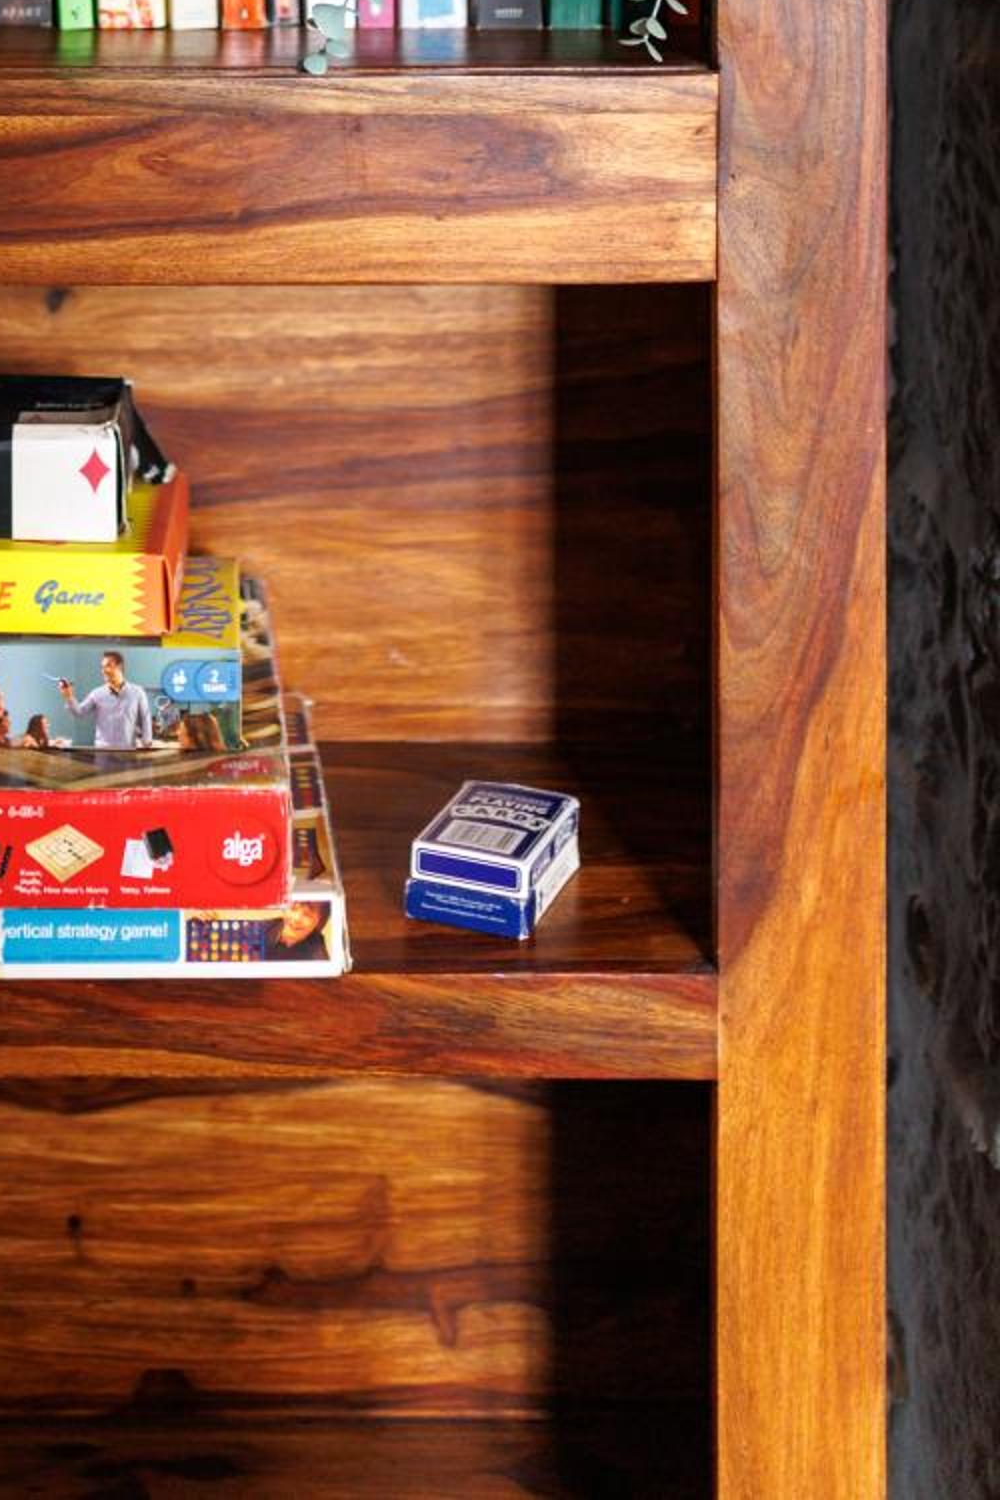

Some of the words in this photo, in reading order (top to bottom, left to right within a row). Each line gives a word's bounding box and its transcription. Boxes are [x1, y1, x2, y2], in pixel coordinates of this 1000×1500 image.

[33, 579, 105, 613] Game
[209, 669, 220, 683] 2
[222, 831, 263, 867] alga
[56, 922, 117, 942] strategy
[119, 921, 169, 942] game!
